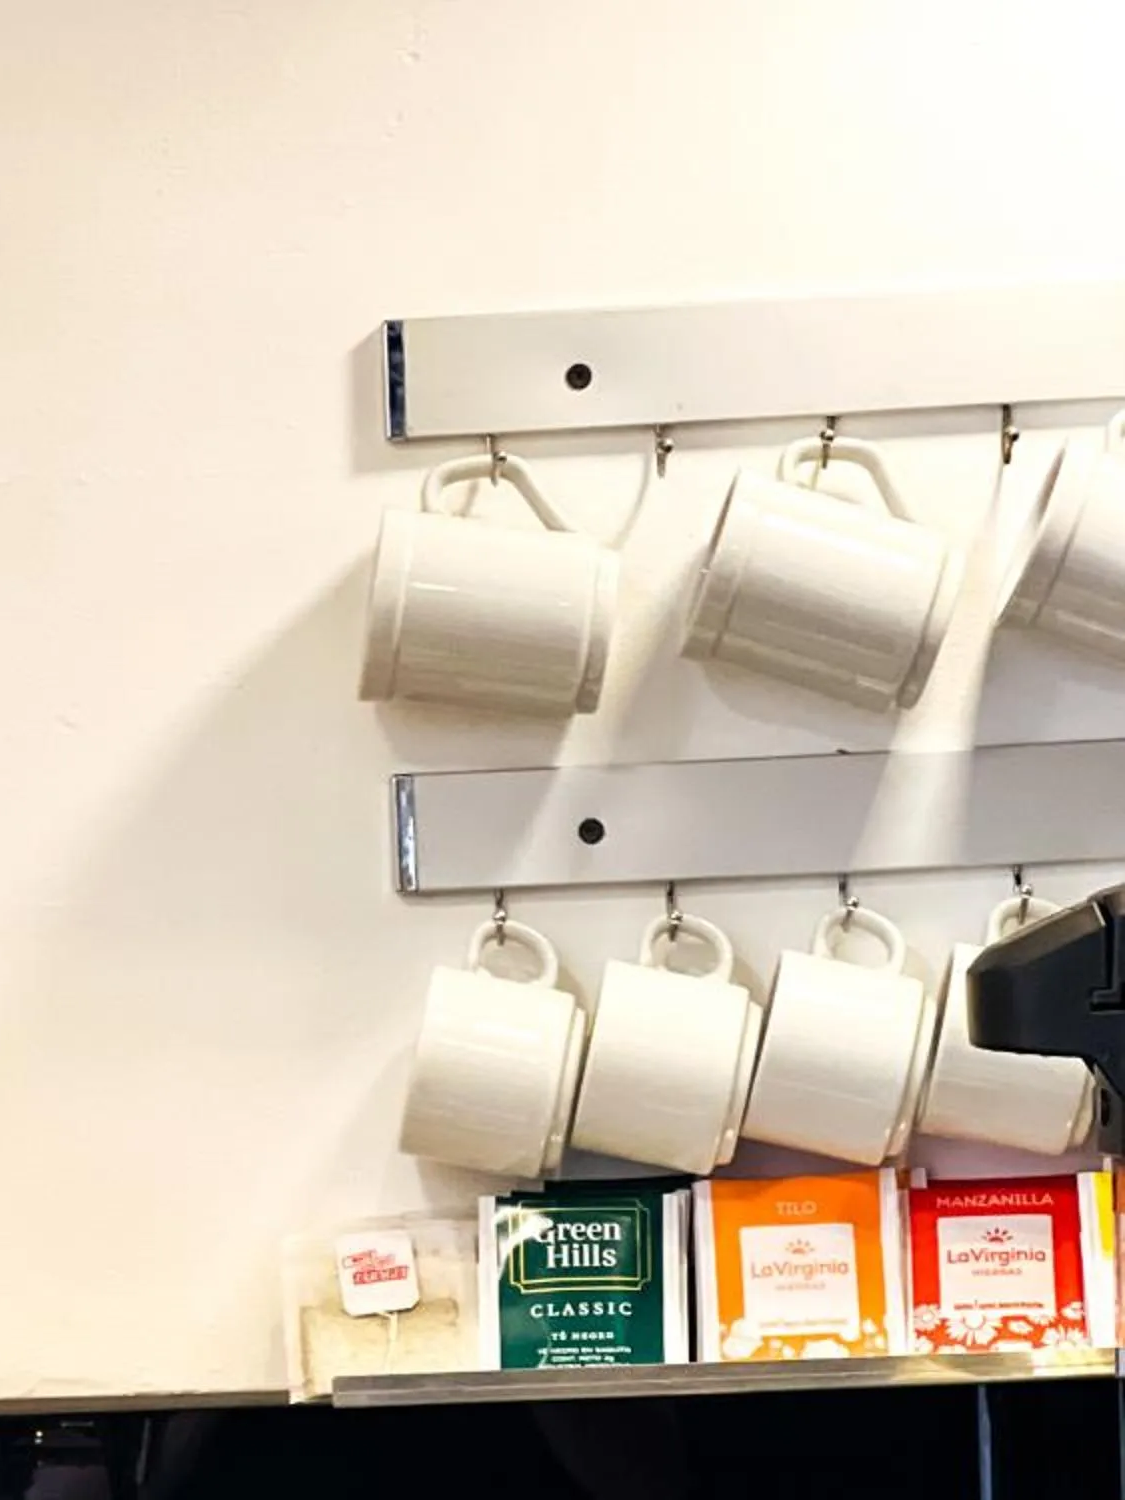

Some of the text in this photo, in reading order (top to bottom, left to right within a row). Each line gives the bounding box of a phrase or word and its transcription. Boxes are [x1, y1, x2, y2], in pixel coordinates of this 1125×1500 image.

[775, 1201, 817, 1216] TILO
[936, 1192, 1055, 1208] MANZANILLA
[536, 1216, 622, 1244] Green
[546, 1244, 617, 1269] Hills
[530, 1301, 633, 1318] CLASSIC
